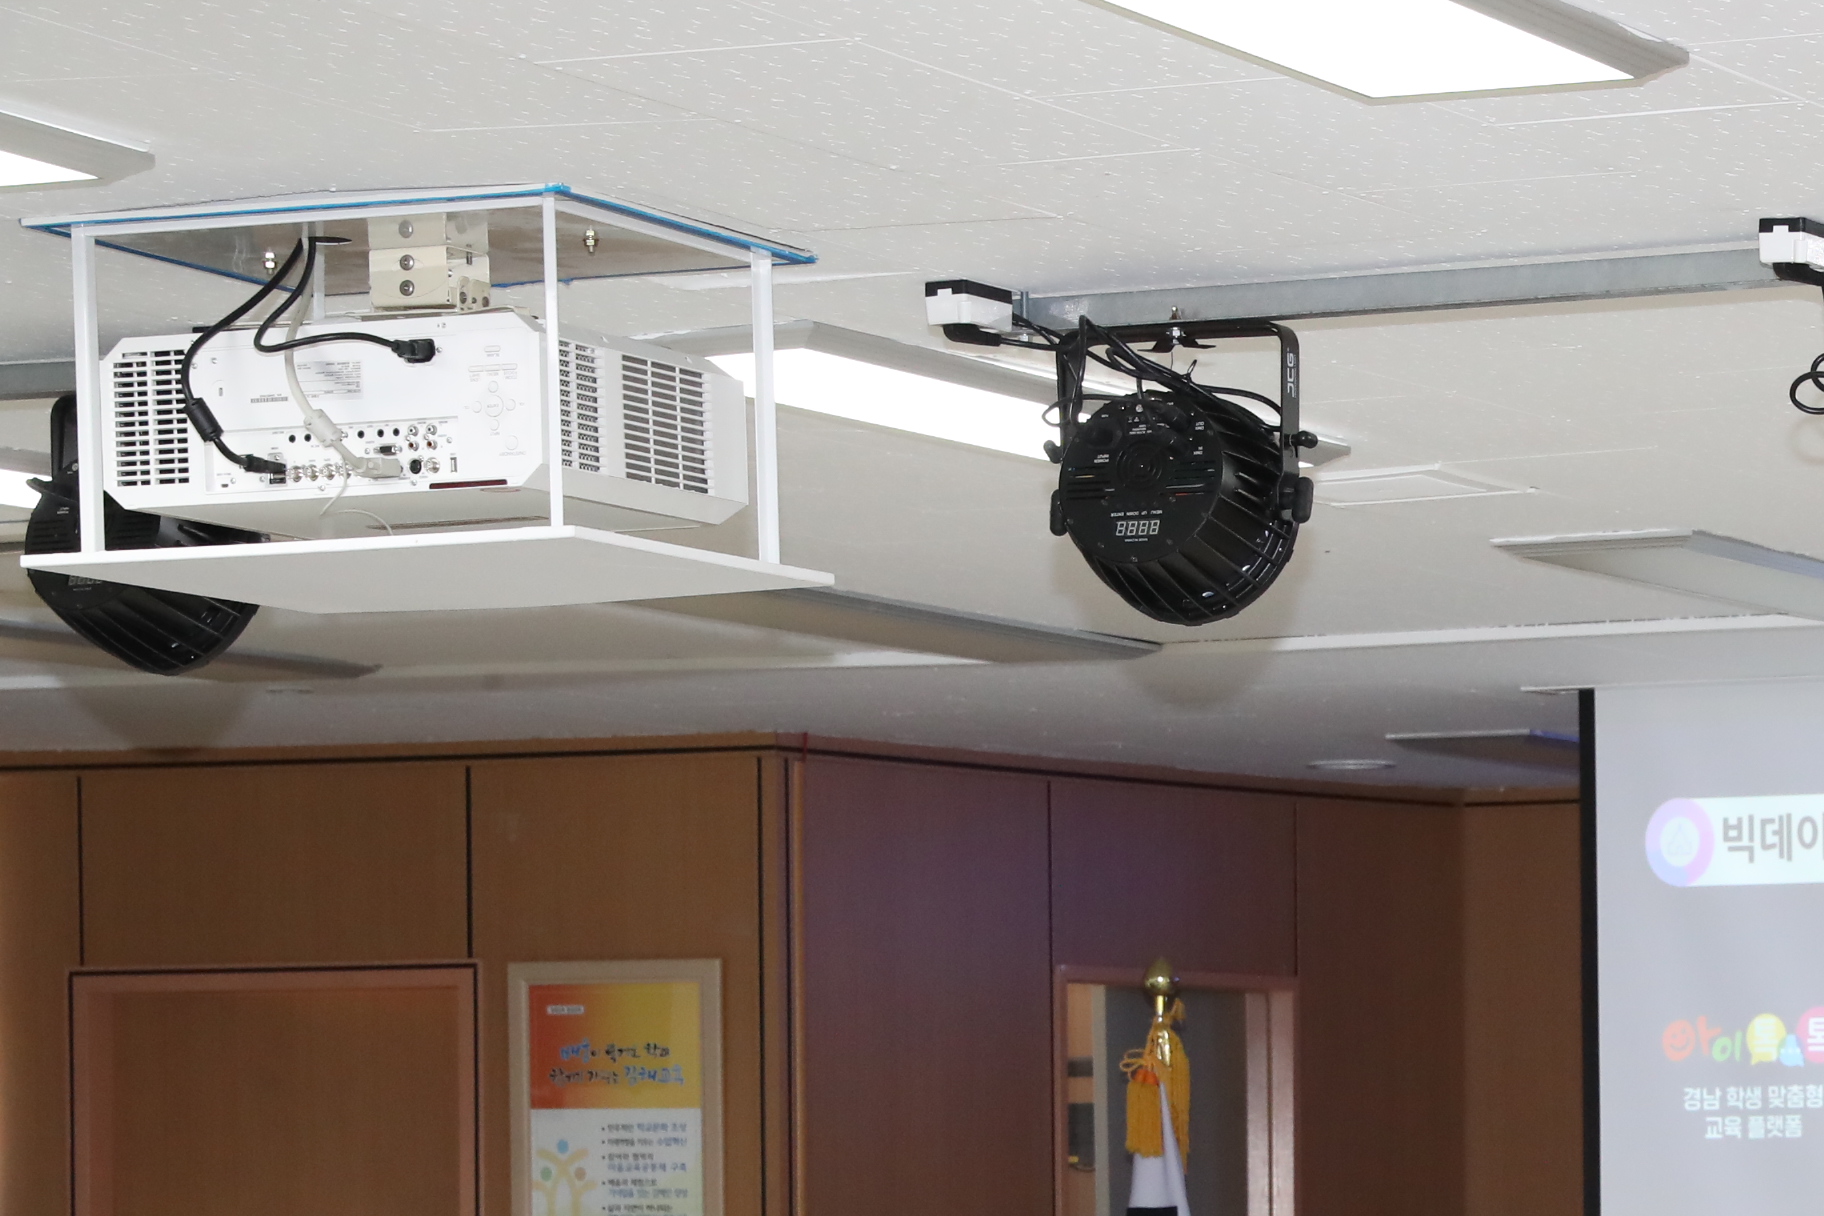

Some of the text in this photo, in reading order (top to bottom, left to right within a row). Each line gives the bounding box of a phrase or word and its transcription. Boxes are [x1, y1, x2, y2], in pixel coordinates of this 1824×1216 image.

[1683, 1083, 1824, 1111] 경남 학생 맞춤형
[1705, 1114, 1803, 1139] 교육 플랫폼
